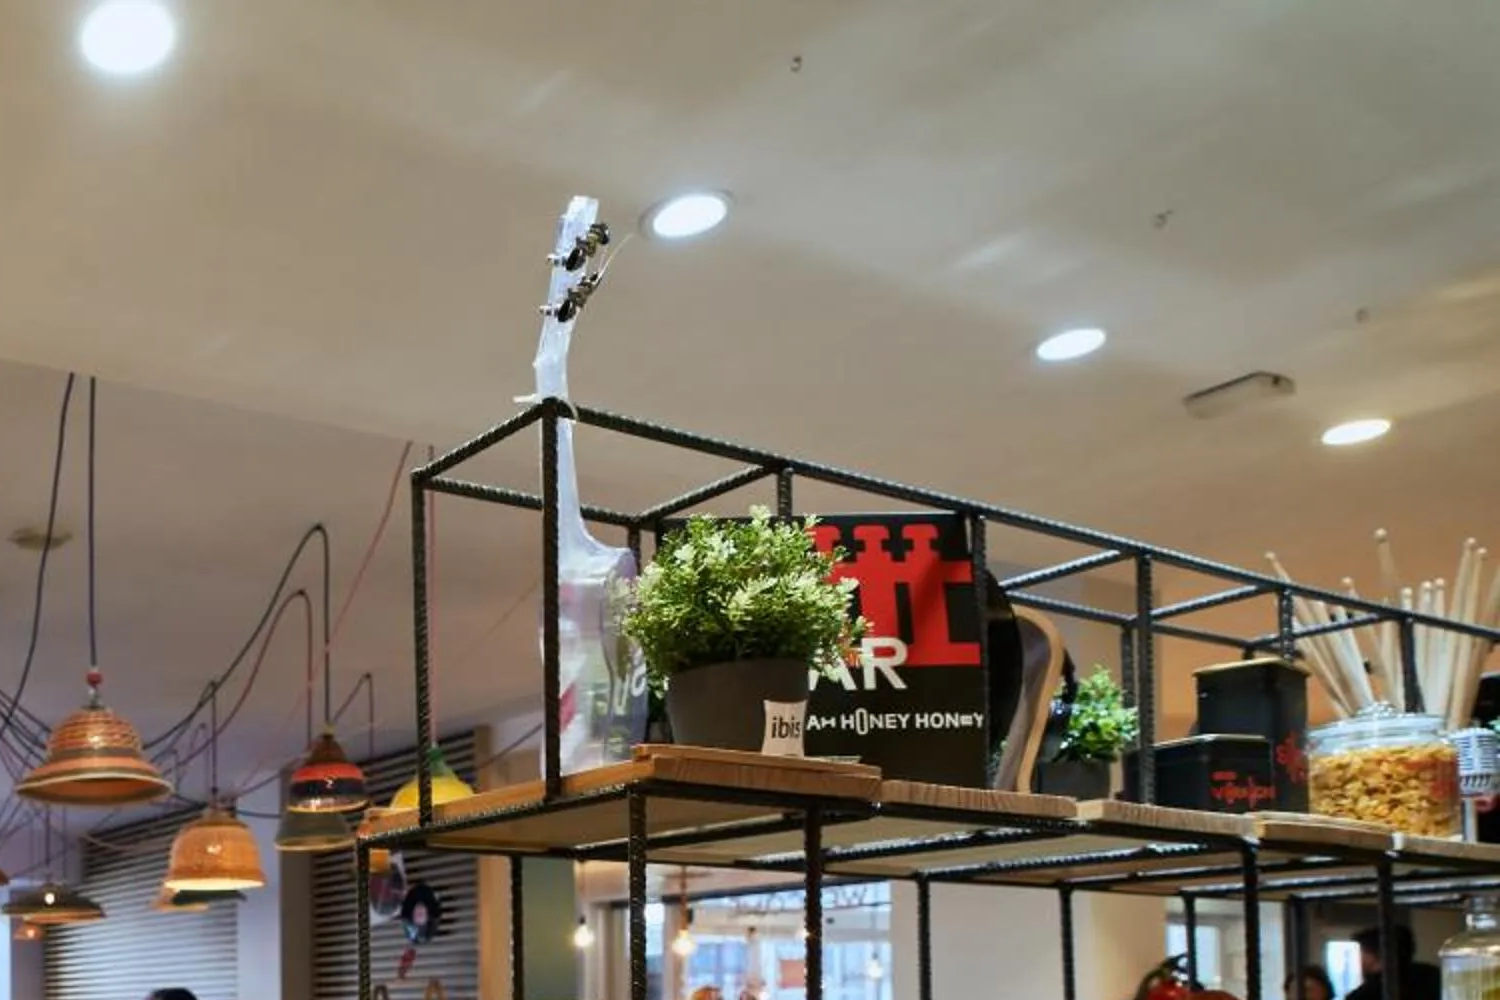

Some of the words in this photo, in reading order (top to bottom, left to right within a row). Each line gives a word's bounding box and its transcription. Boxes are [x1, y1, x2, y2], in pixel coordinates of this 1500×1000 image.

[771, 715, 802, 739] ibis
[841, 708, 910, 735] HONEY
[915, 712, 984, 729] HONEY
